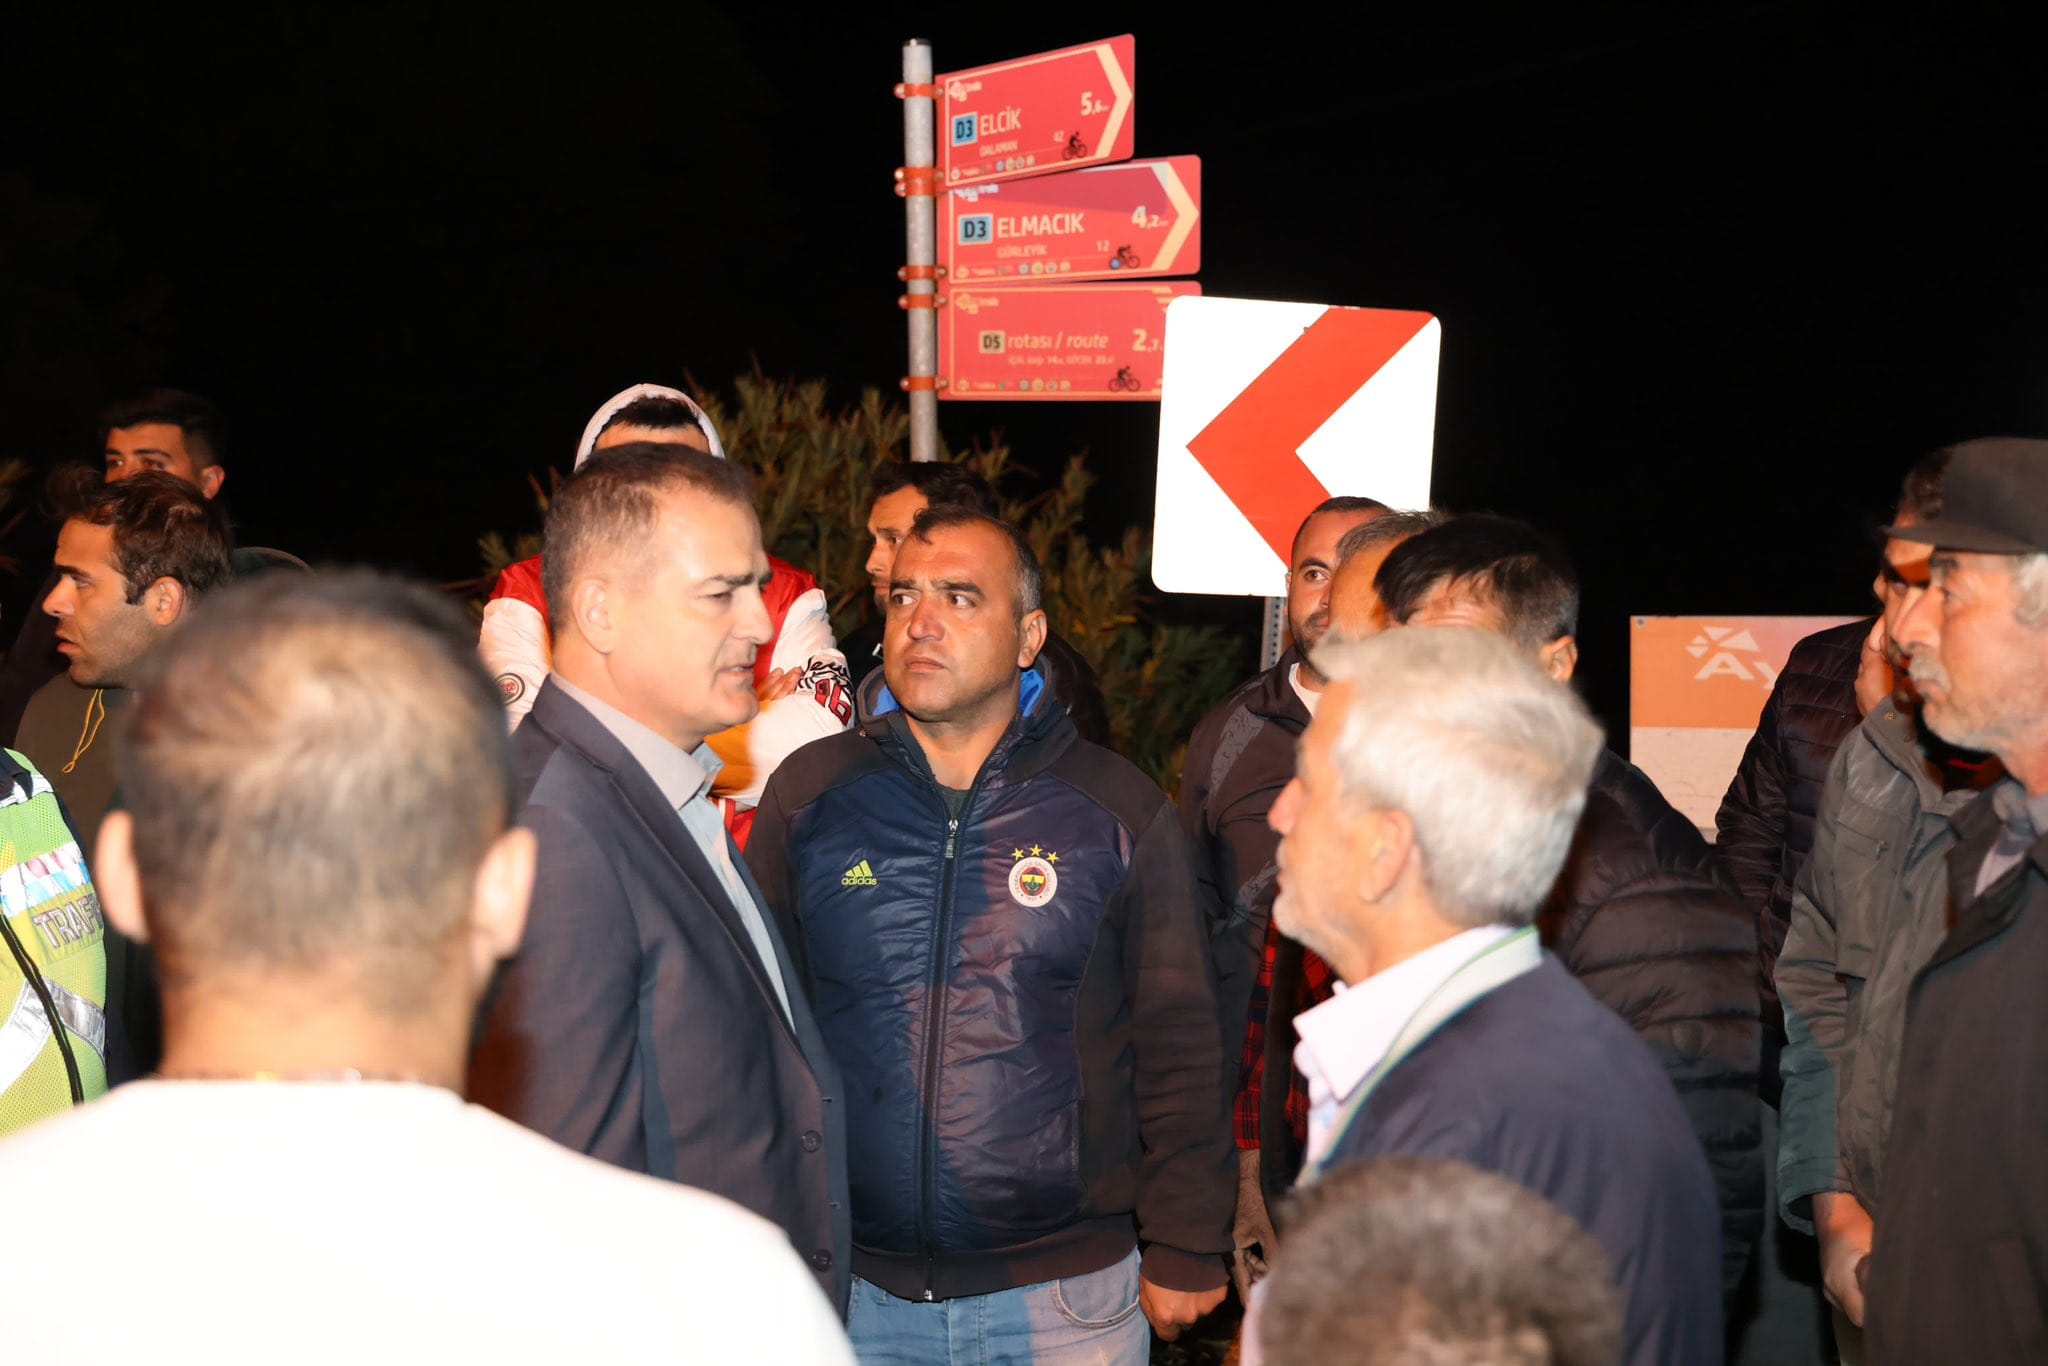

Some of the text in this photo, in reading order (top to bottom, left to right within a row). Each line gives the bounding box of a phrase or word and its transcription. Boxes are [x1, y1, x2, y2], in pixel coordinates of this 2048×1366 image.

[956, 106, 1021, 139] D3 ELCİK
[964, 211, 1085, 239] D3 ELMACIK
[1096, 239, 1110, 253] 12
[1008, 333, 1052, 349] rotası
[1066, 333, 1109, 349] route
[841, 875, 878, 887] adidas
